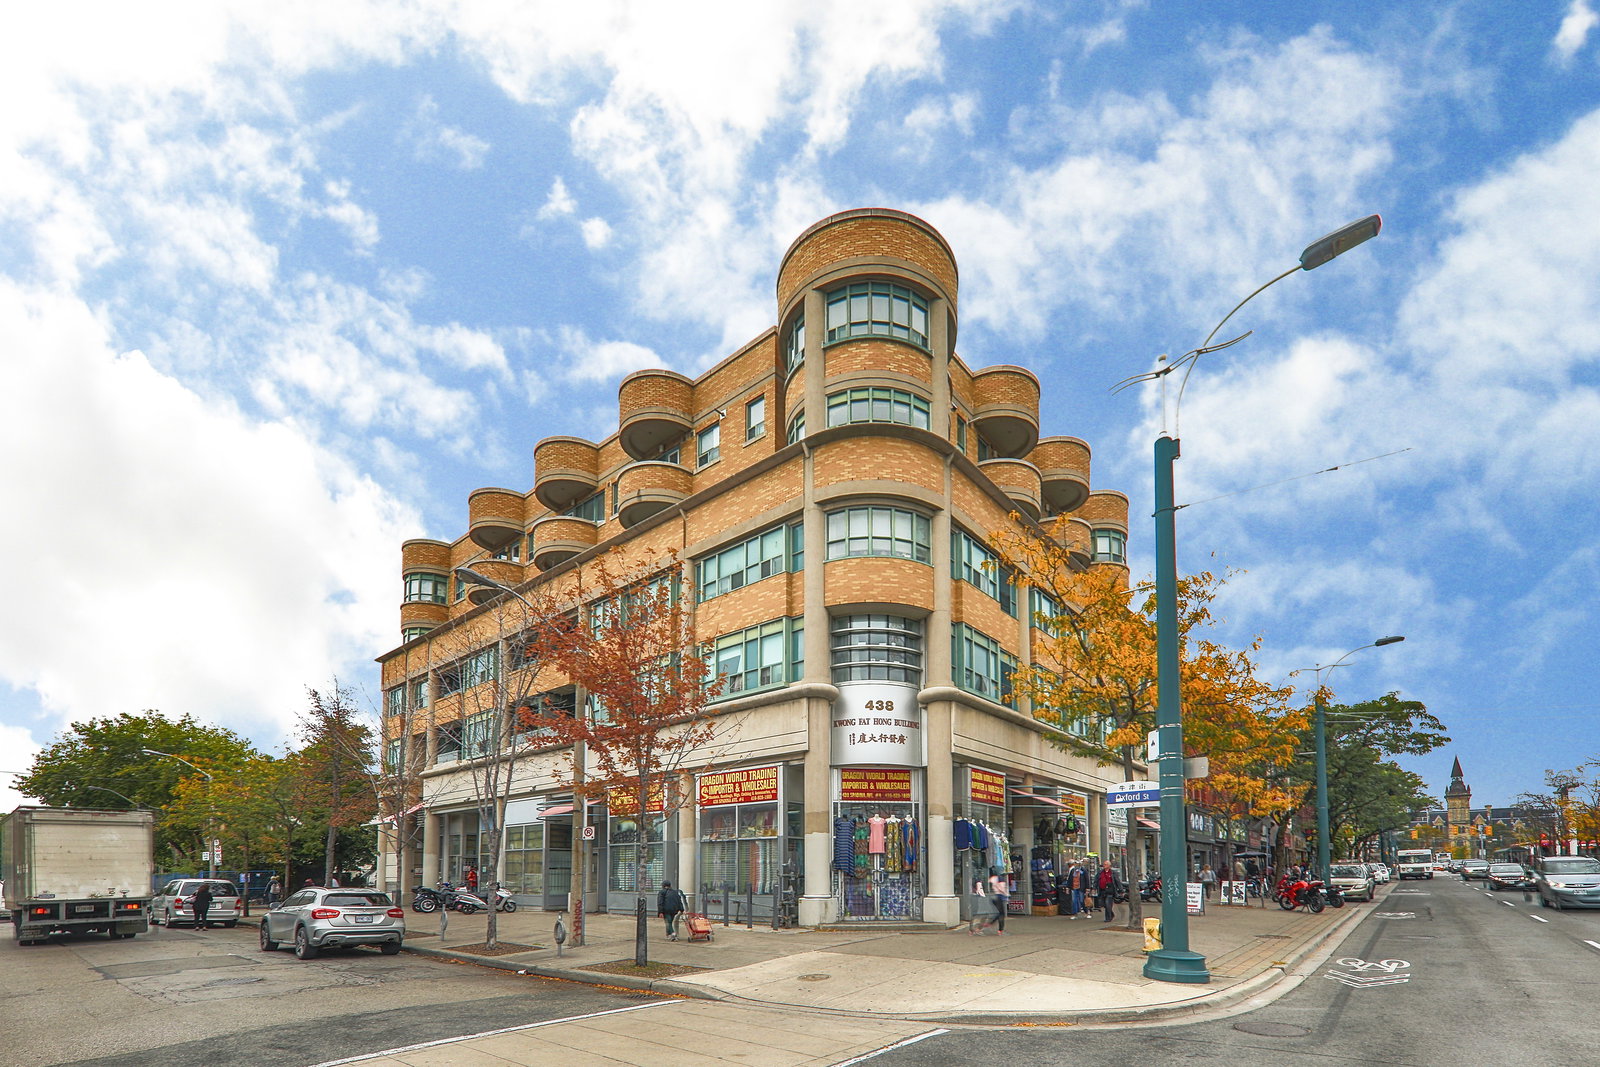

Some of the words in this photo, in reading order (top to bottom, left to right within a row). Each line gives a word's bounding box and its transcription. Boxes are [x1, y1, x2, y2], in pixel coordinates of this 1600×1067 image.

[865, 700, 894, 711] 438
[833, 719, 856, 727] KWONG
[894, 719, 919, 729] BUILDING
[701, 774, 724, 786] DRAGON
[725, 771, 747, 783] WORLD
[749, 767, 776, 780] TRADING
[709, 784, 734, 795] IMPORTER
[735, 783, 740, 792] &
[742, 779, 776, 792] WHOLESALER
[1116, 793, 1140, 802] Oxford
